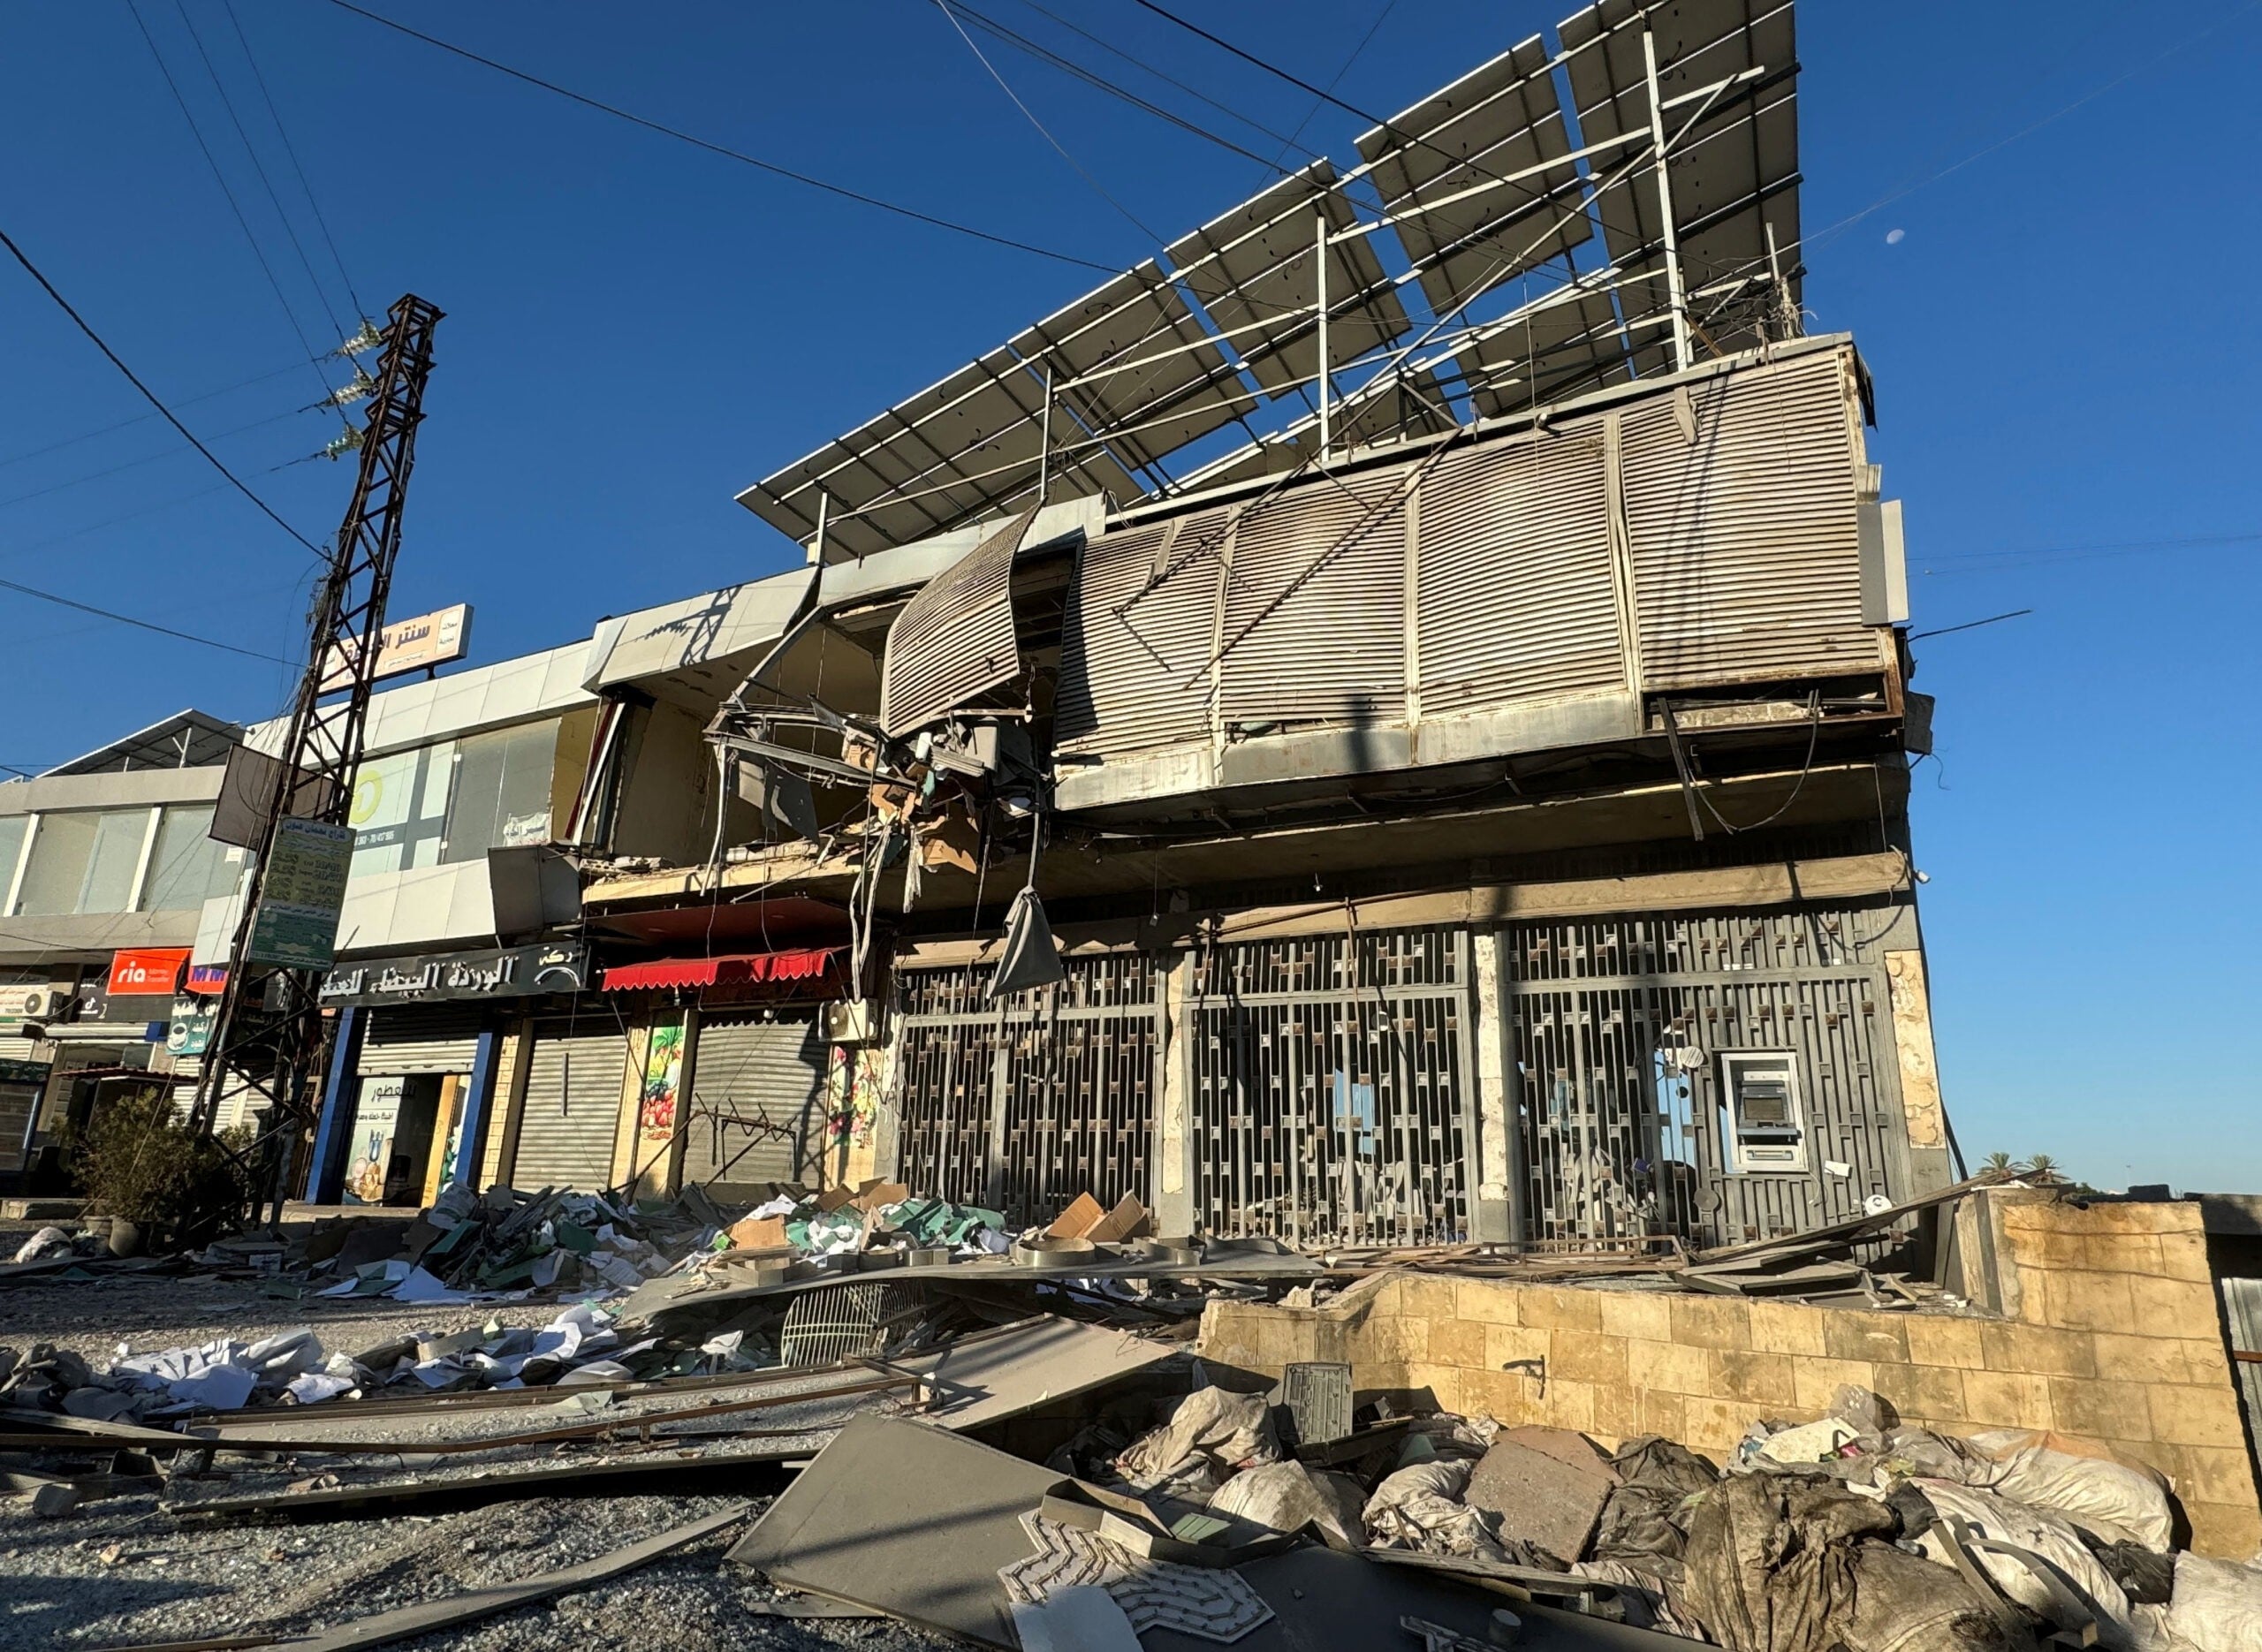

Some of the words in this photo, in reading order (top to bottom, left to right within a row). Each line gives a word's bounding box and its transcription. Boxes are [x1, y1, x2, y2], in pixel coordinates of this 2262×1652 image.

[395, 624, 431, 649] سنتر
[118, 960, 146, 983] ria
[447, 956, 515, 991] الوردة
